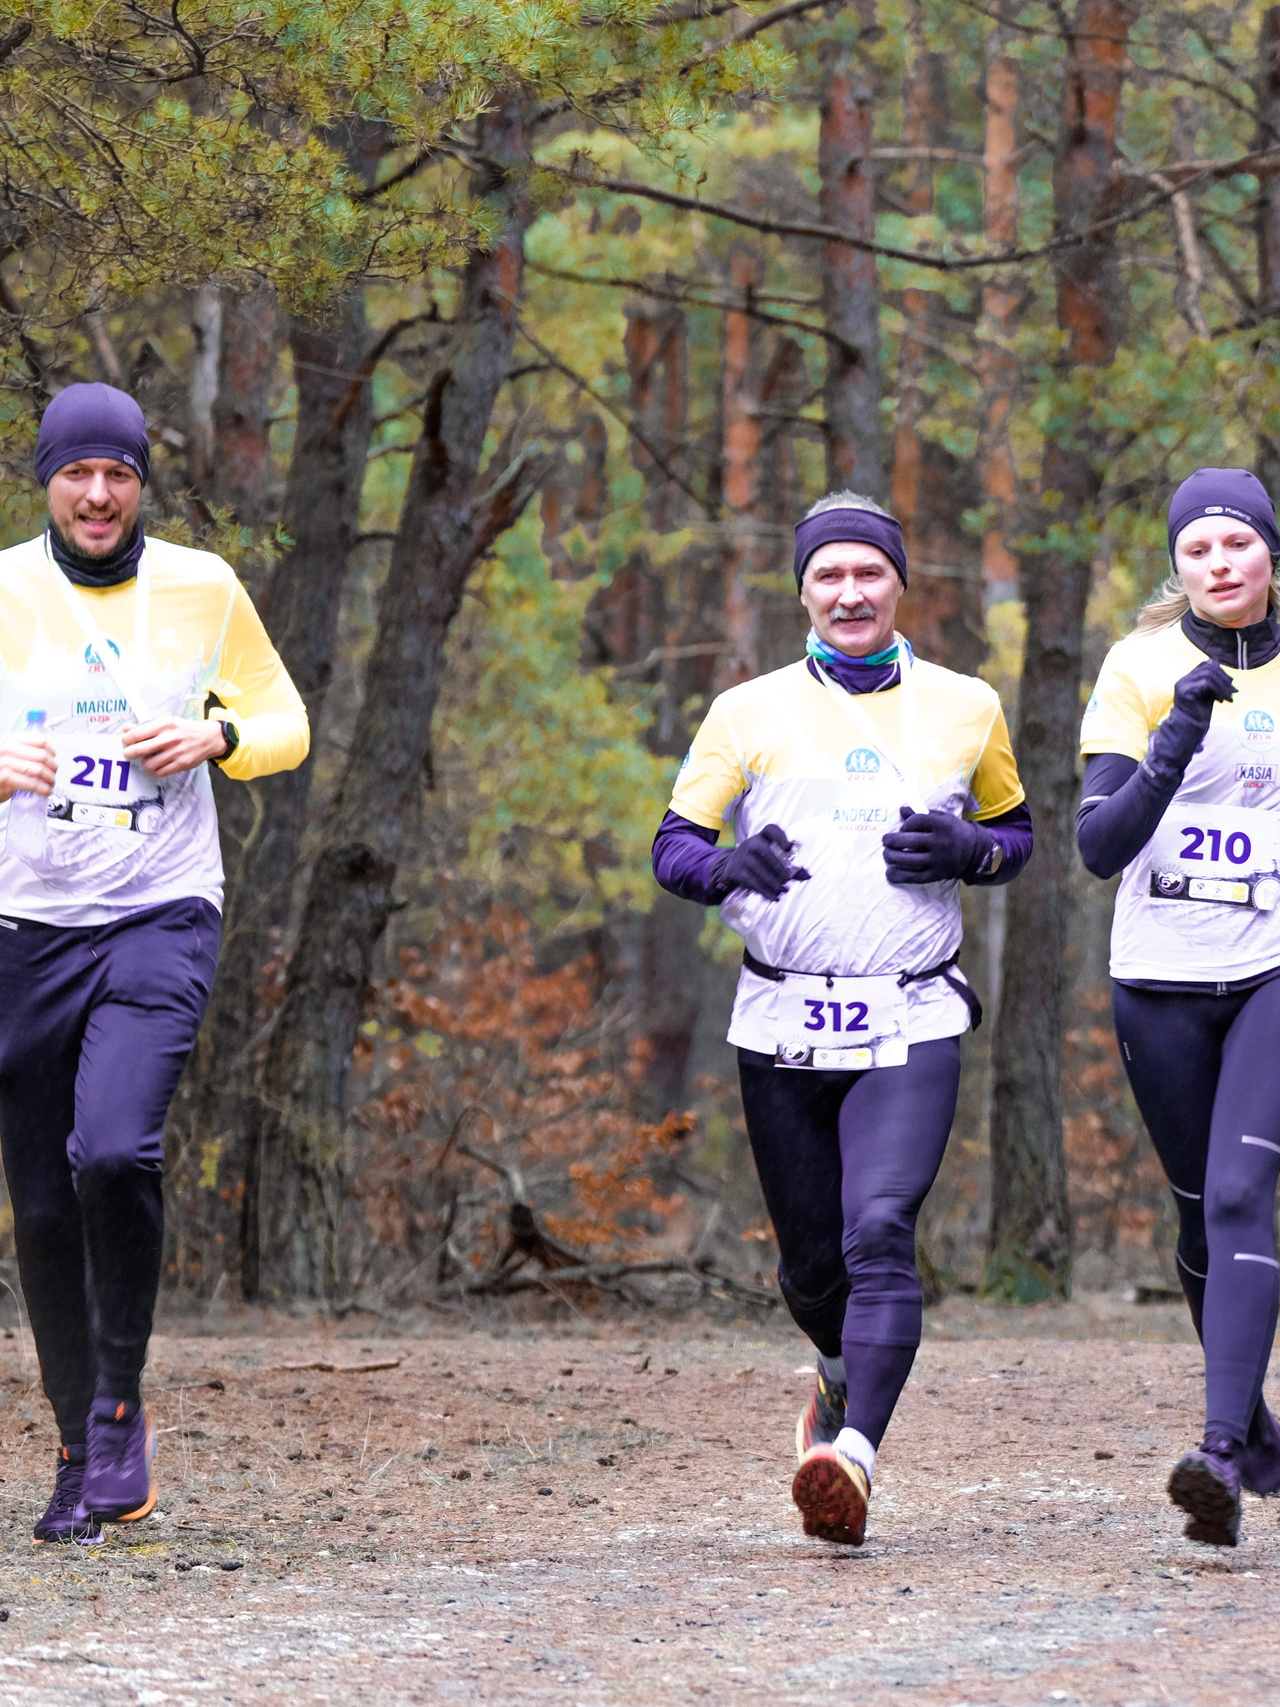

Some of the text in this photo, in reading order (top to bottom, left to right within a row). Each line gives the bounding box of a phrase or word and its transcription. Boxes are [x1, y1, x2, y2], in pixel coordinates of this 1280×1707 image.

[76, 698, 127, 714] MARCIN
[69, 755, 131, 792] 211
[1239, 765, 1273, 780] KASIA
[832, 808, 888, 822] ANDRZEJ
[1179, 826, 1252, 865] 210
[803, 998, 869, 1032] 312
